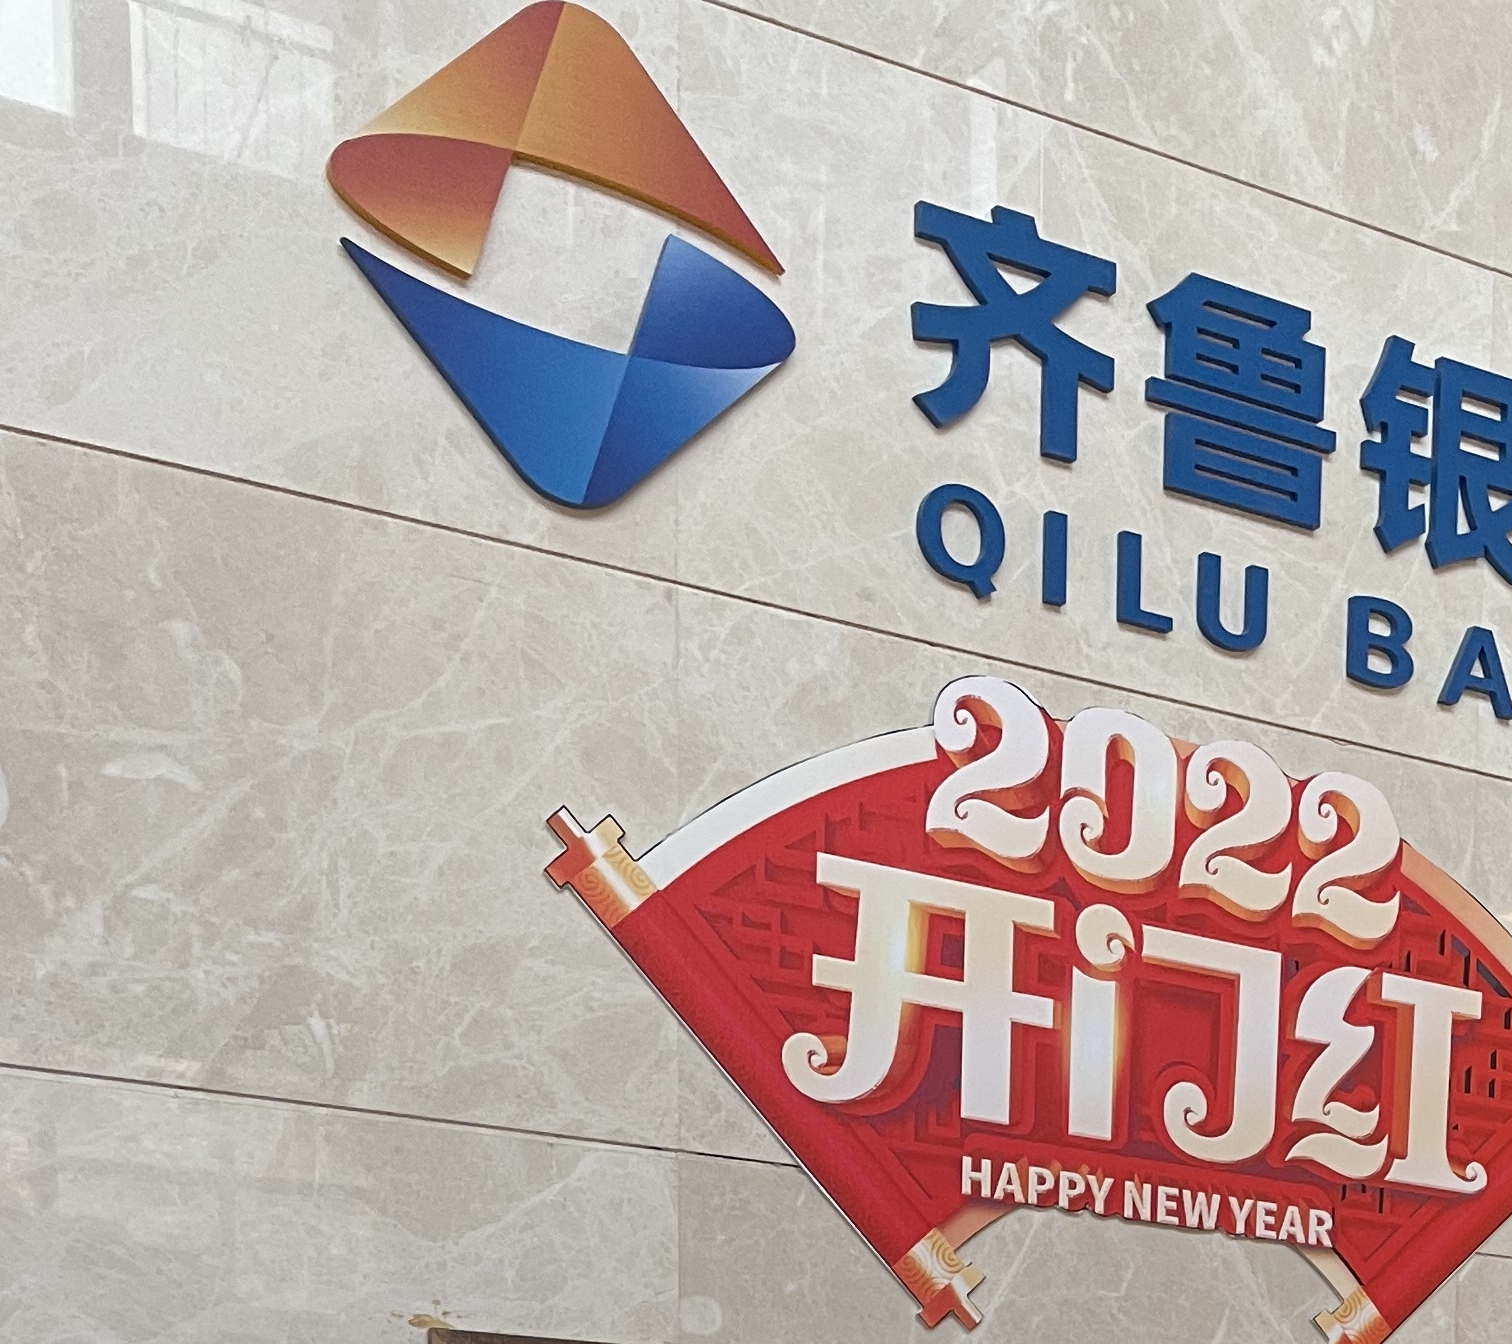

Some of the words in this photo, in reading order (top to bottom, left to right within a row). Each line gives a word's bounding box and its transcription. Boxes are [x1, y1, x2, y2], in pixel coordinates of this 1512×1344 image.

[915, 483, 1270, 653] QILU
[925, 675, 1402, 946] 2022
[781, 852, 1489, 1195] 开门红
[960, 1155, 1113, 1217] HAPPY
[1124, 1180, 1230, 1230] NEW
[1229, 1197, 1335, 1249] YEAR
